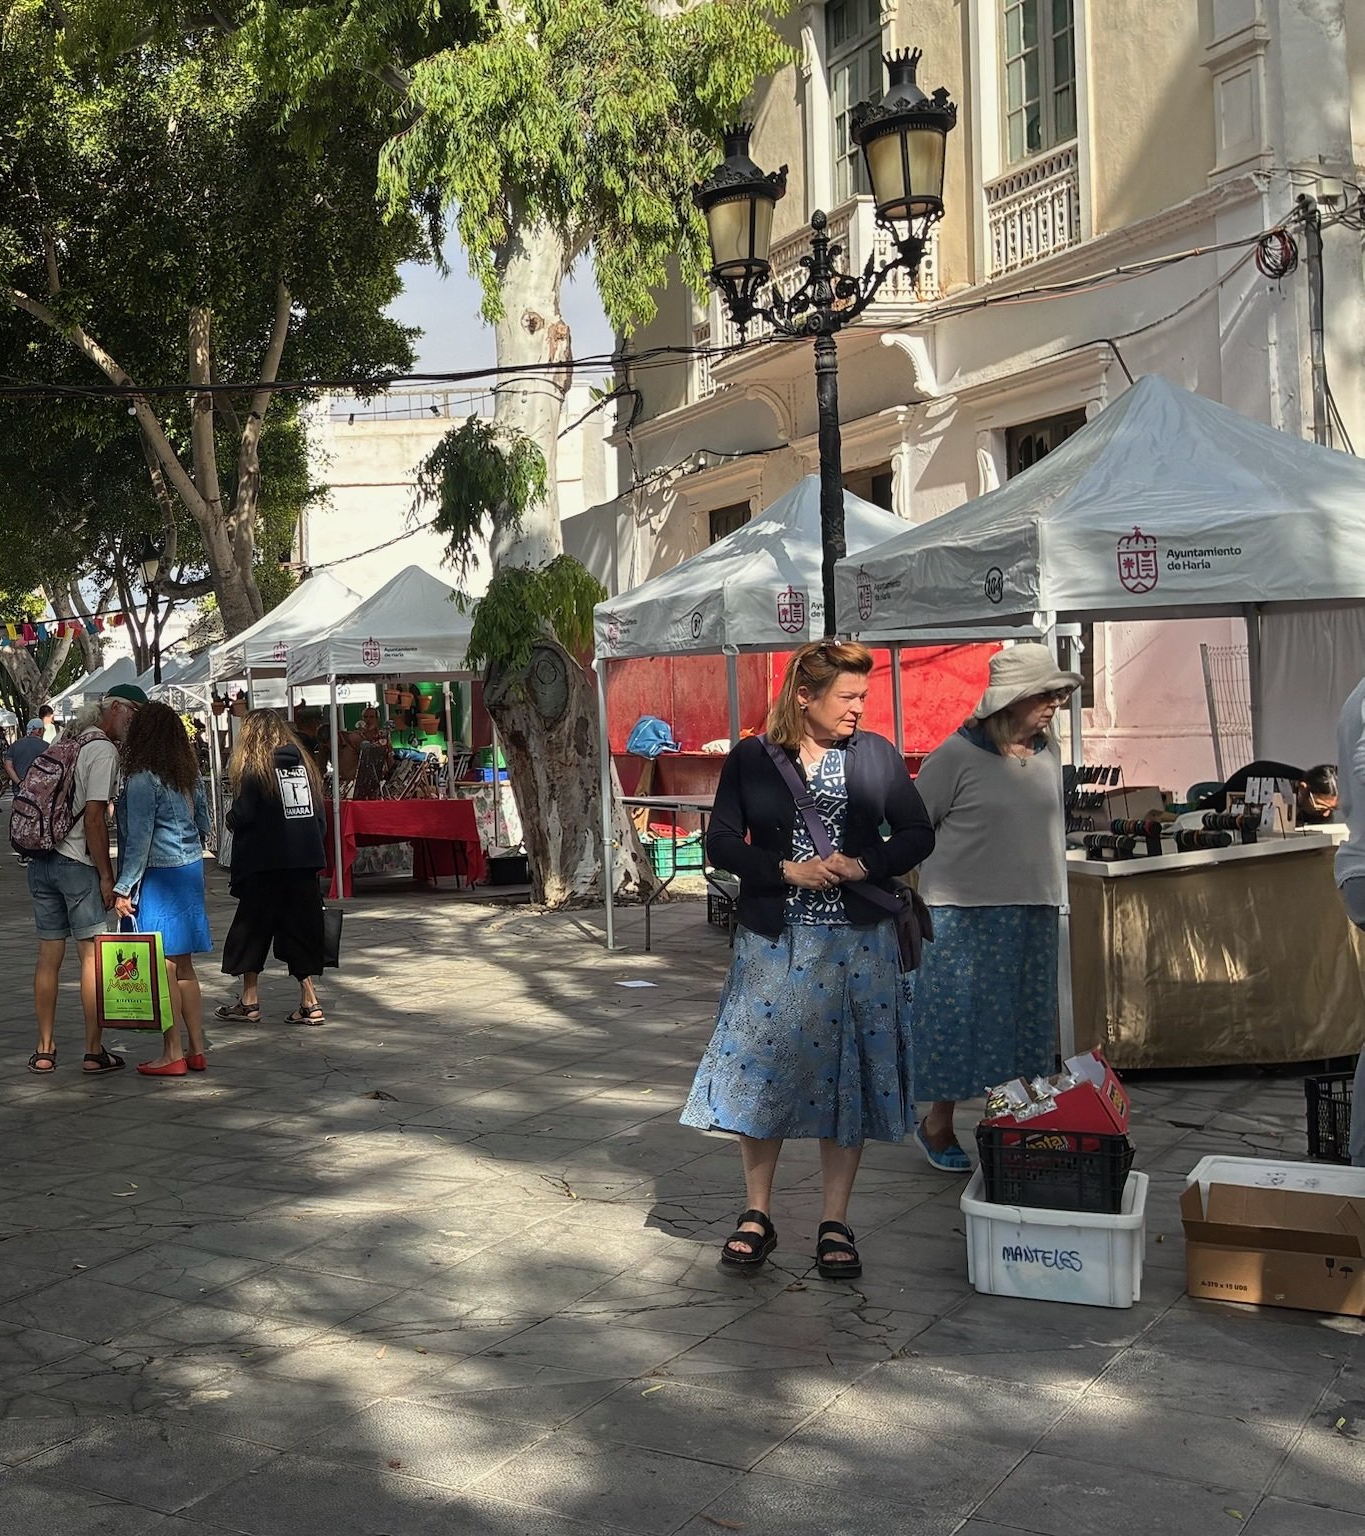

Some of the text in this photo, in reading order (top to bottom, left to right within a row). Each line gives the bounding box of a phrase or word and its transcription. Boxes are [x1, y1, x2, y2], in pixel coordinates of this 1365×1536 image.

[1166, 546, 1242, 560] Ayuntamiento
[1167, 559, 1211, 571] de Haría
[1002, 1244, 1083, 1272] MANTELES
